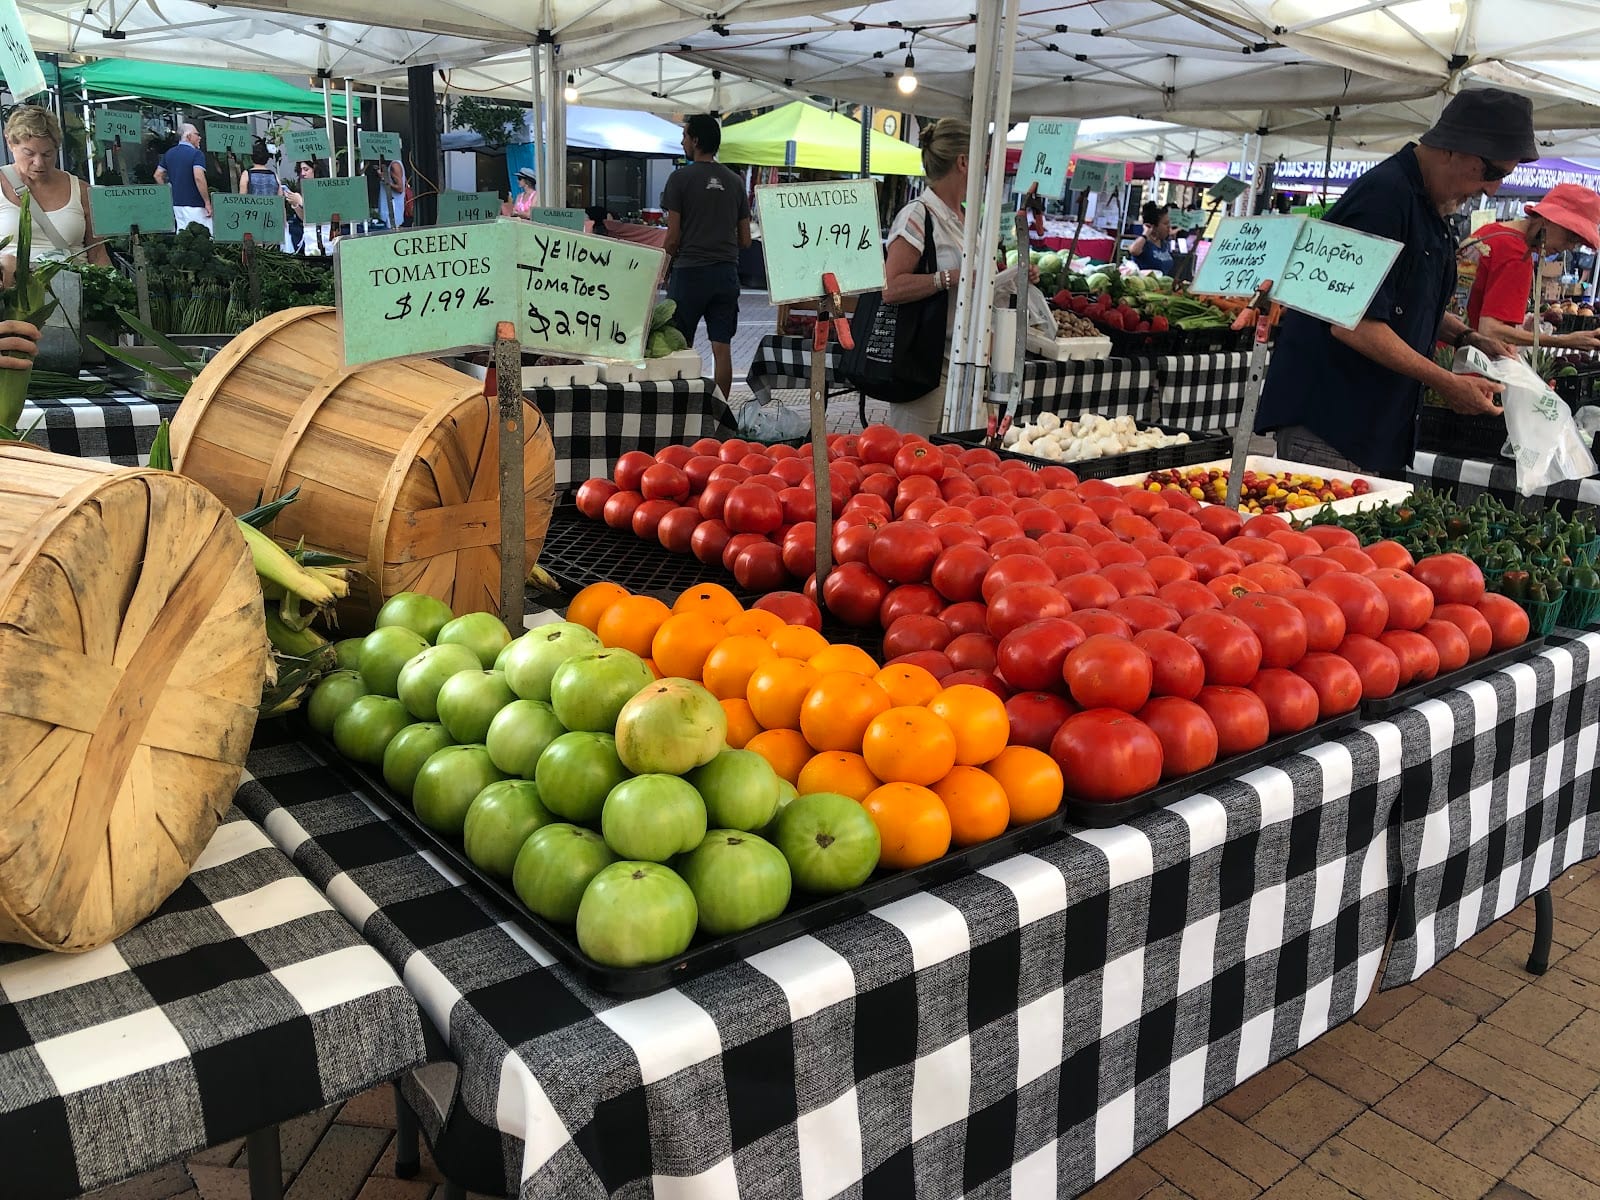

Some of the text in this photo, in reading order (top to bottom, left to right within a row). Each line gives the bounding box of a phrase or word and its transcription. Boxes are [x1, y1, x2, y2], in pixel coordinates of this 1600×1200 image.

[104, 111, 133, 119] BROCCOLI
[1038, 123, 1063, 135] GARLIC
[317, 179, 350, 187] PARSLEY
[104, 188, 157, 197] CILANTRO
[223, 196, 274, 206] ASPARAGUS
[776, 189, 858, 209] TOMATOES
[543, 210, 574, 218] CABBAGE
[393, 232, 467, 257] GREEN
[369, 256, 491, 287] TOMATOES
[1284, 261, 1328, 282] 2.00
[528, 302, 627, 344] $2.99 lb
